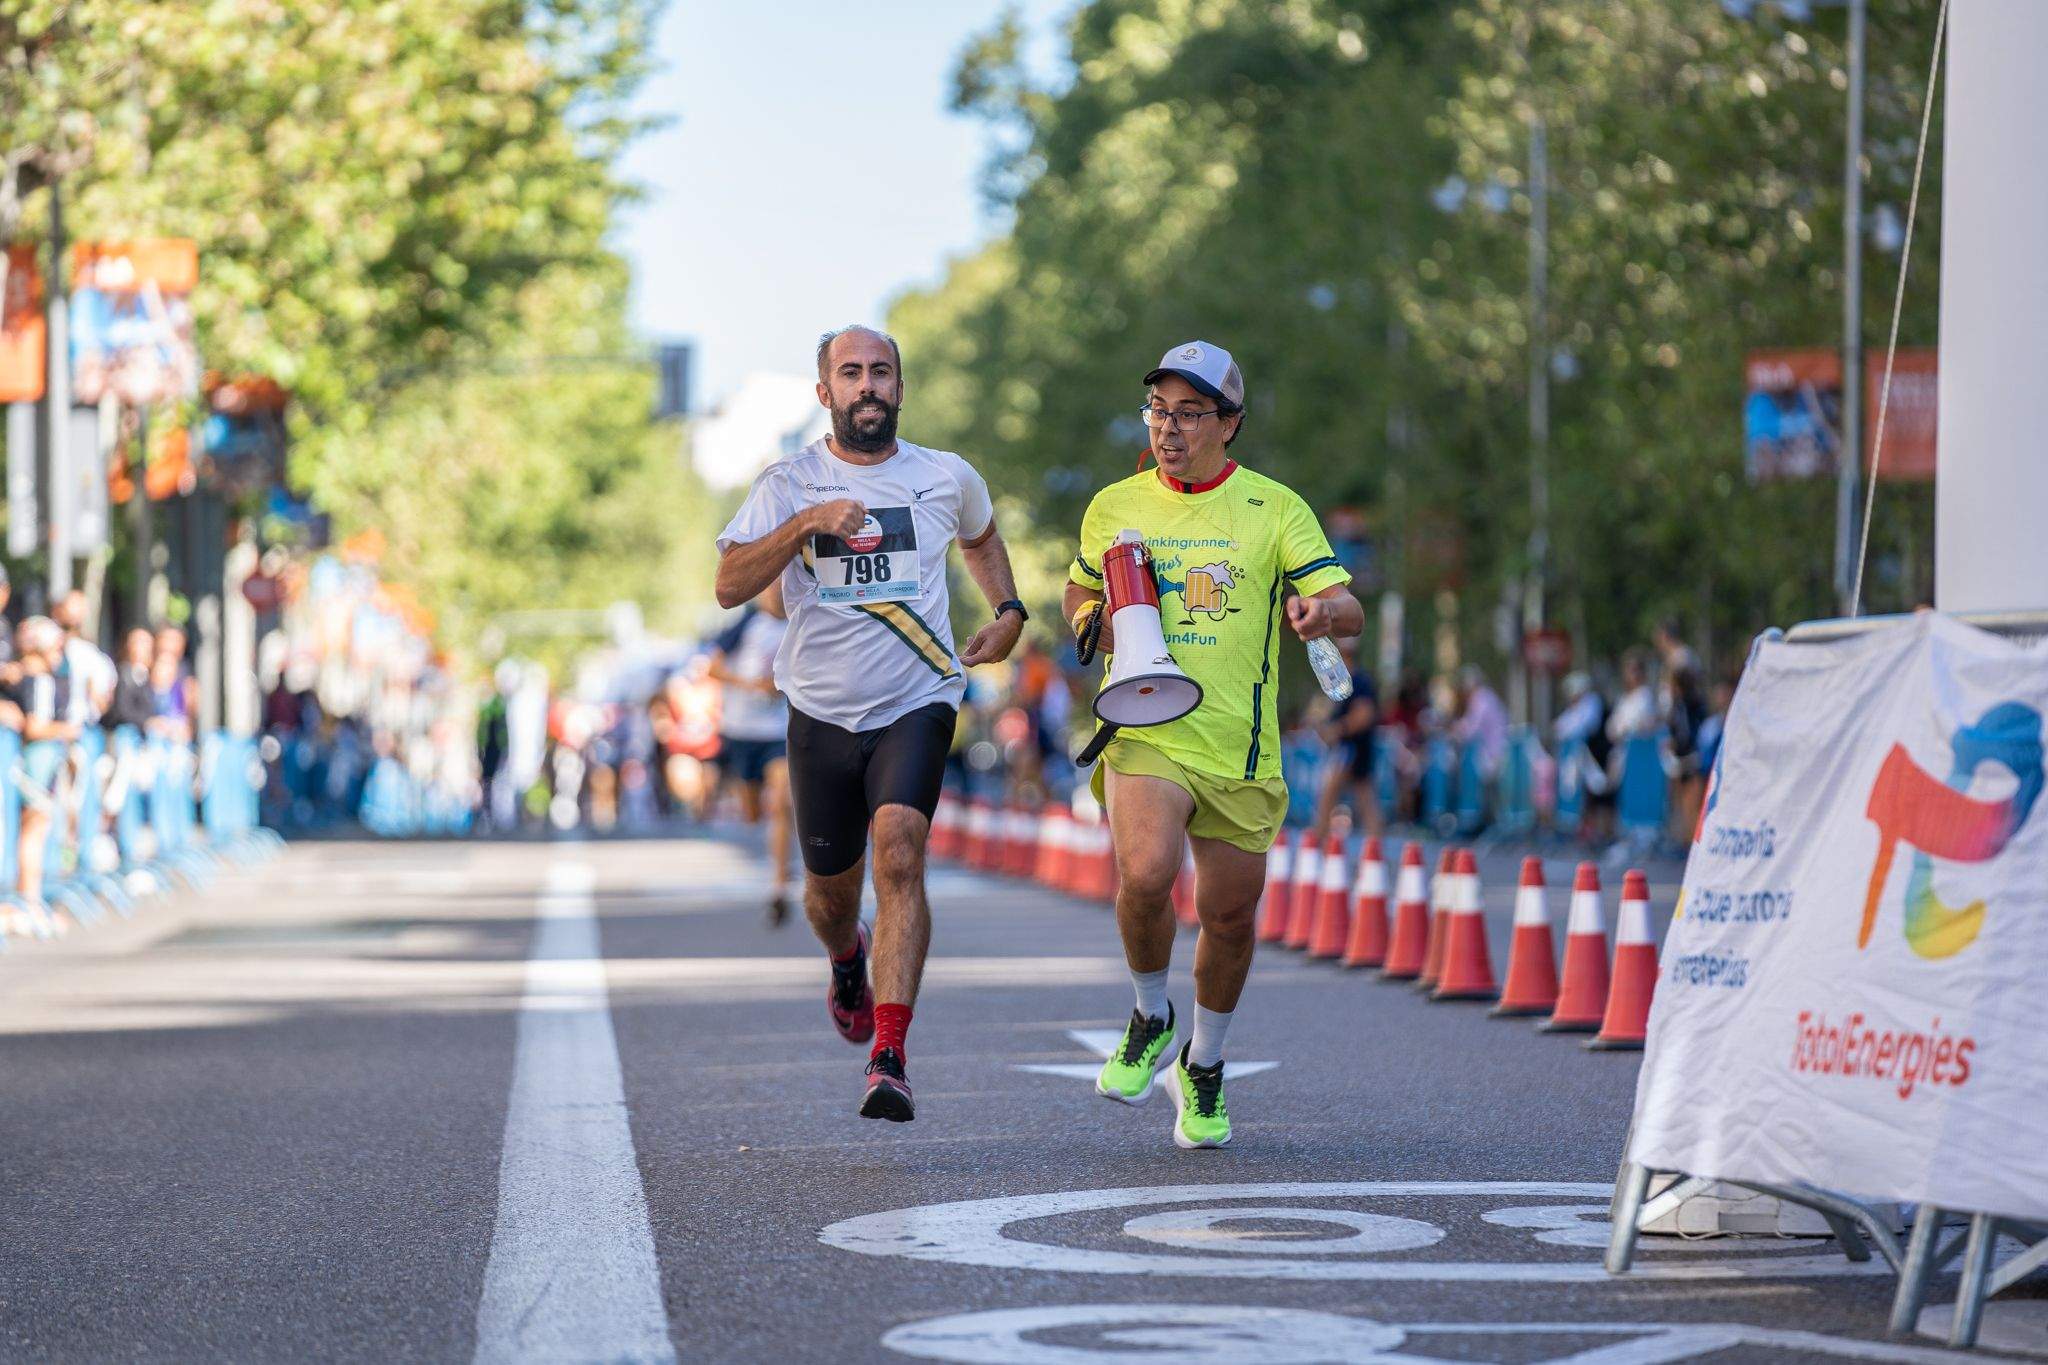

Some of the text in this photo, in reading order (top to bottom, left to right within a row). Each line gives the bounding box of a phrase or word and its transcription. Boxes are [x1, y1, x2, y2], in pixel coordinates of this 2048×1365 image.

[1144, 536, 1231, 550] rinkingrunner
[840, 554, 891, 586] 798
[1163, 632, 1217, 646] un4Fun
[1790, 1010, 1977, 1100] TotalEnergies
